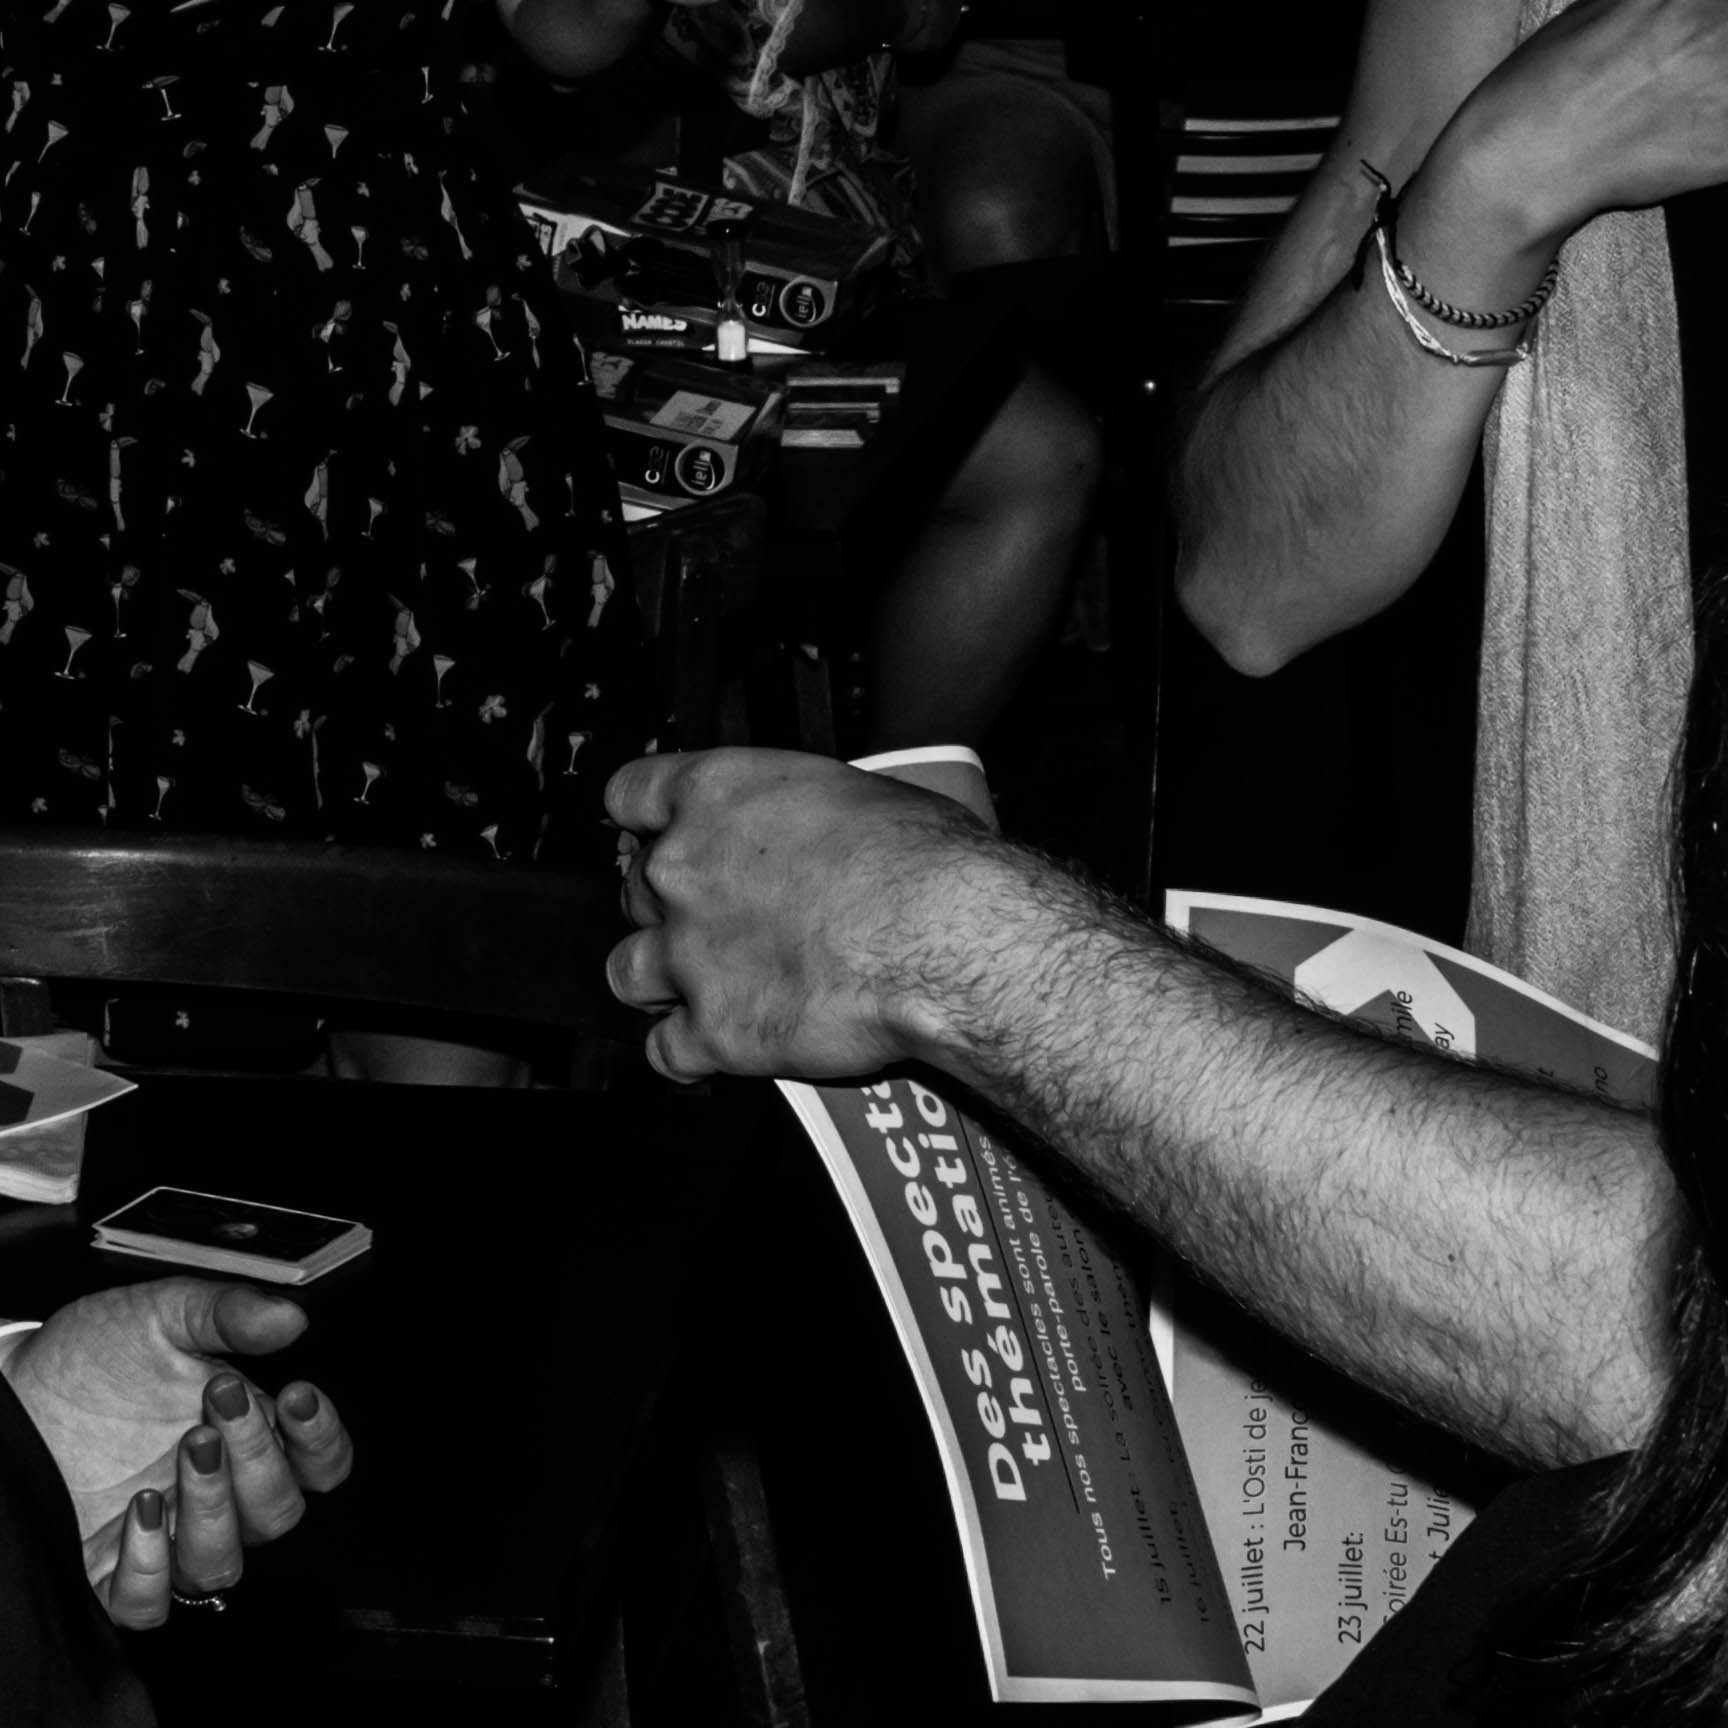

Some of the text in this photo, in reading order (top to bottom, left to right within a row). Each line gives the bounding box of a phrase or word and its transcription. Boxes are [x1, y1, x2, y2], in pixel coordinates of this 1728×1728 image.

[1016, 1190, 1035, 1225] de
[1028, 1231, 1088, 1393] porte-parole
[979, 1134, 1117, 1581] Tous nos spectacles sont animés
[961, 1348, 1028, 1502] Des
[1241, 1405, 1268, 1441] de
[1242, 1447, 1266, 1519] L'Osti
[1383, 1479, 1410, 1546] Es-tu
[1240, 1532, 1271, 1615] juillet
[1244, 1620, 1266, 1655] 22
[1337, 1615, 1363, 1644] 23
